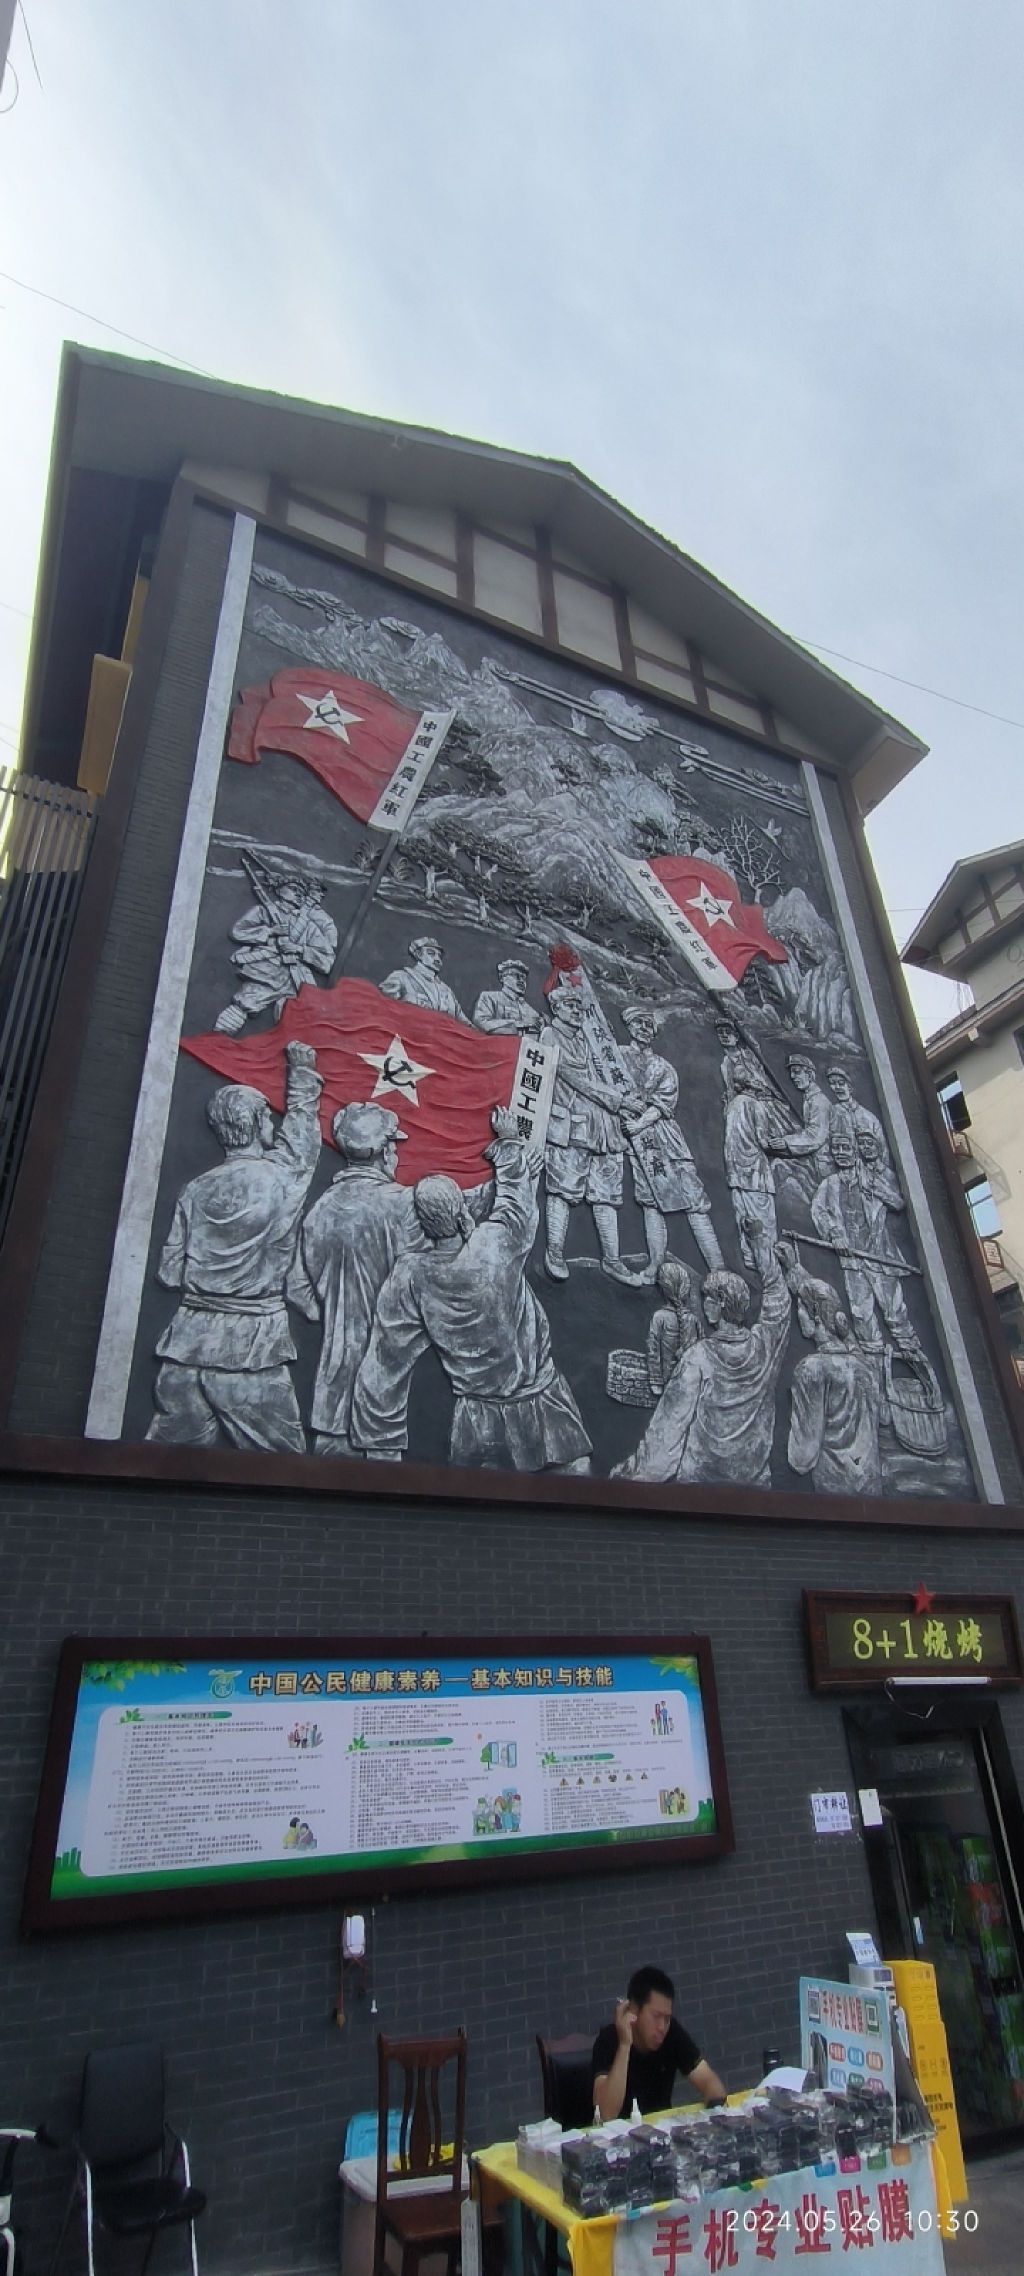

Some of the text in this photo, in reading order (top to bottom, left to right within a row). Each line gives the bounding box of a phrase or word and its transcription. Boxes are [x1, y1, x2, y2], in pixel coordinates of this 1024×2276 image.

[853, 1617, 984, 1663] 8+1烧烤
[652, 2179, 914, 2276] 手机专业贴膜
